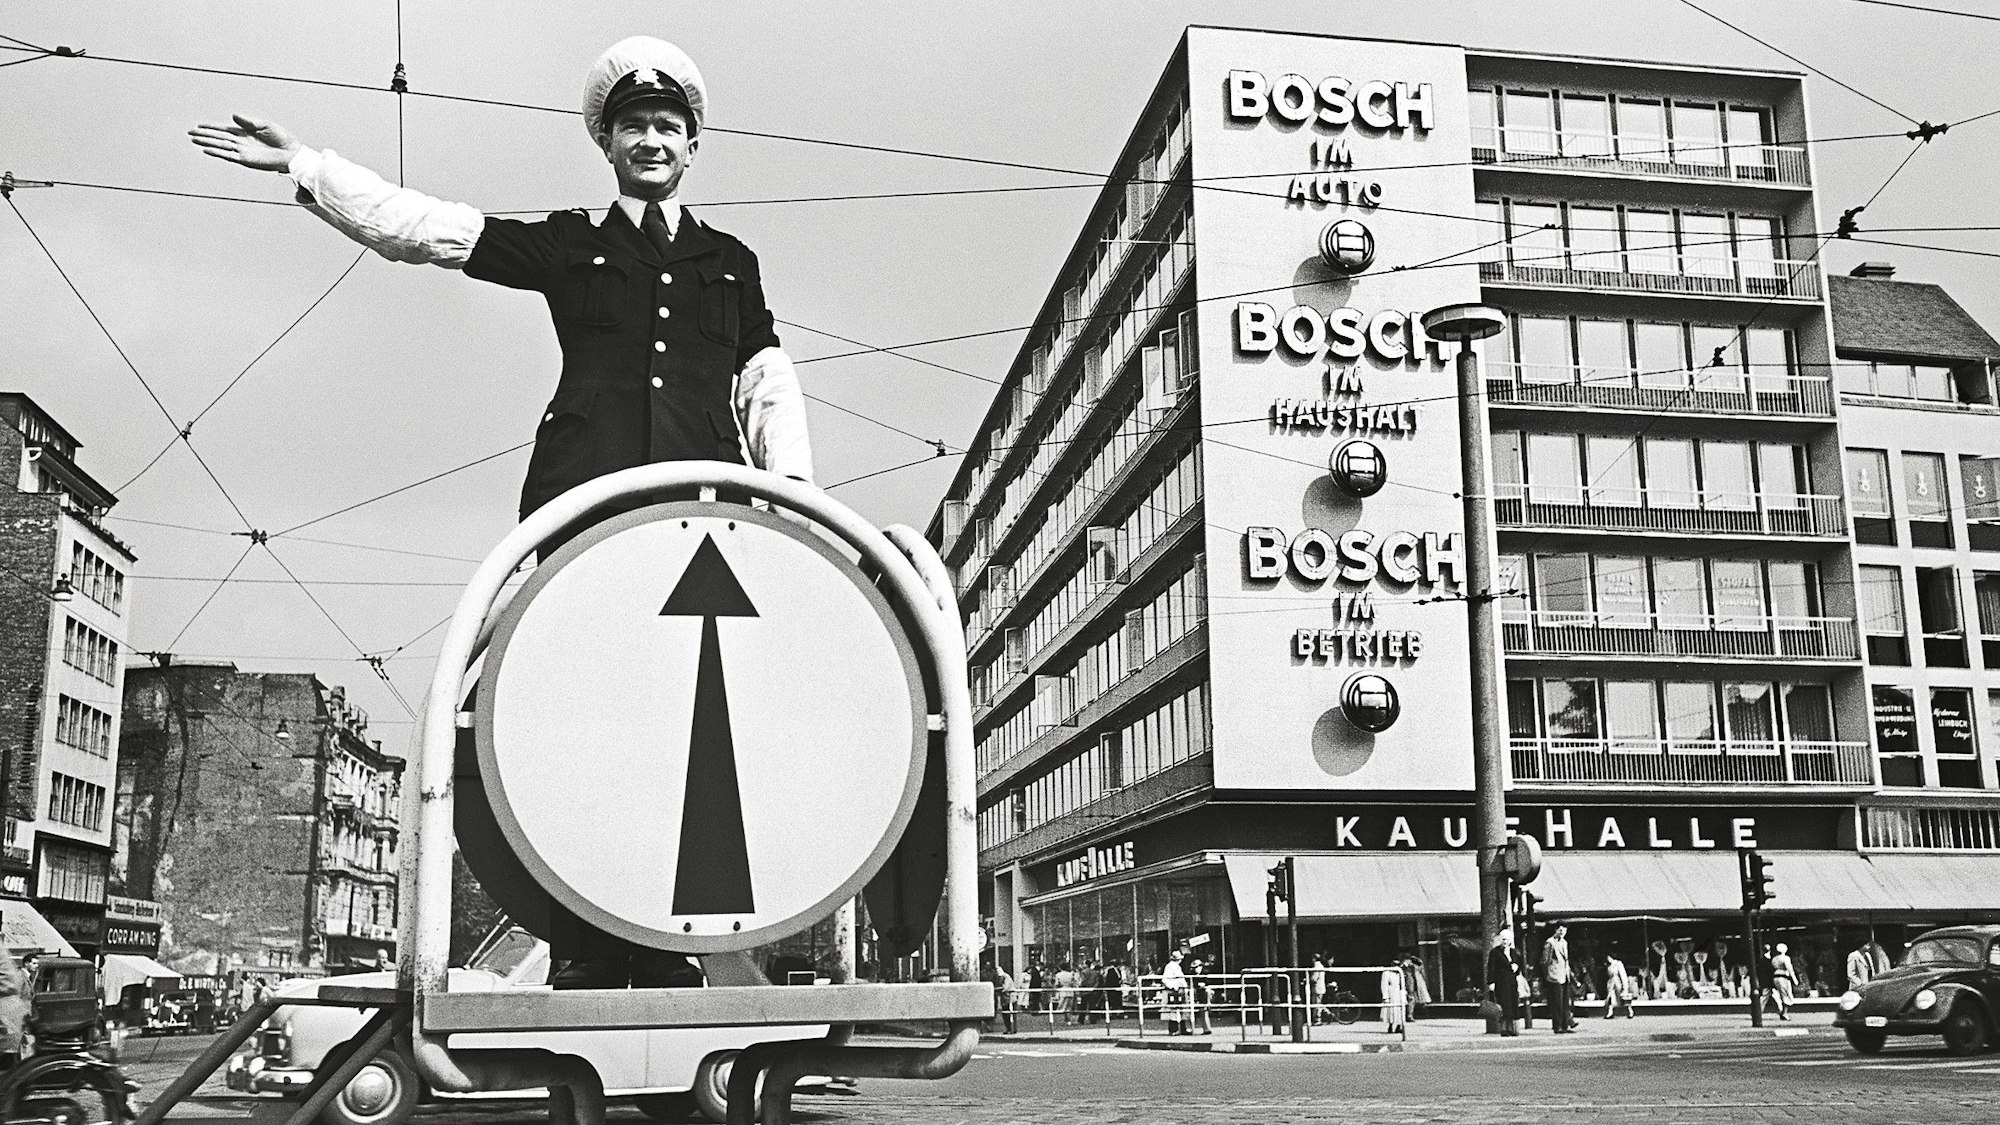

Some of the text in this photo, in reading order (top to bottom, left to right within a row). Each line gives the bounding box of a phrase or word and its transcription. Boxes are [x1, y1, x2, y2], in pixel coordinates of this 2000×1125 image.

[1228, 69, 1435, 129] BOSCH
[1314, 137, 1352, 164] IM
[1289, 175, 1383, 206] AUTO
[1238, 302, 1452, 361] BOSCH
[1324, 364, 1364, 392] IM
[1274, 398, 1424, 431] HAUSHALT
[1247, 526, 1466, 583] BOSCH
[1336, 591, 1377, 619] IM
[1297, 628, 1424, 658] BETRIEB
